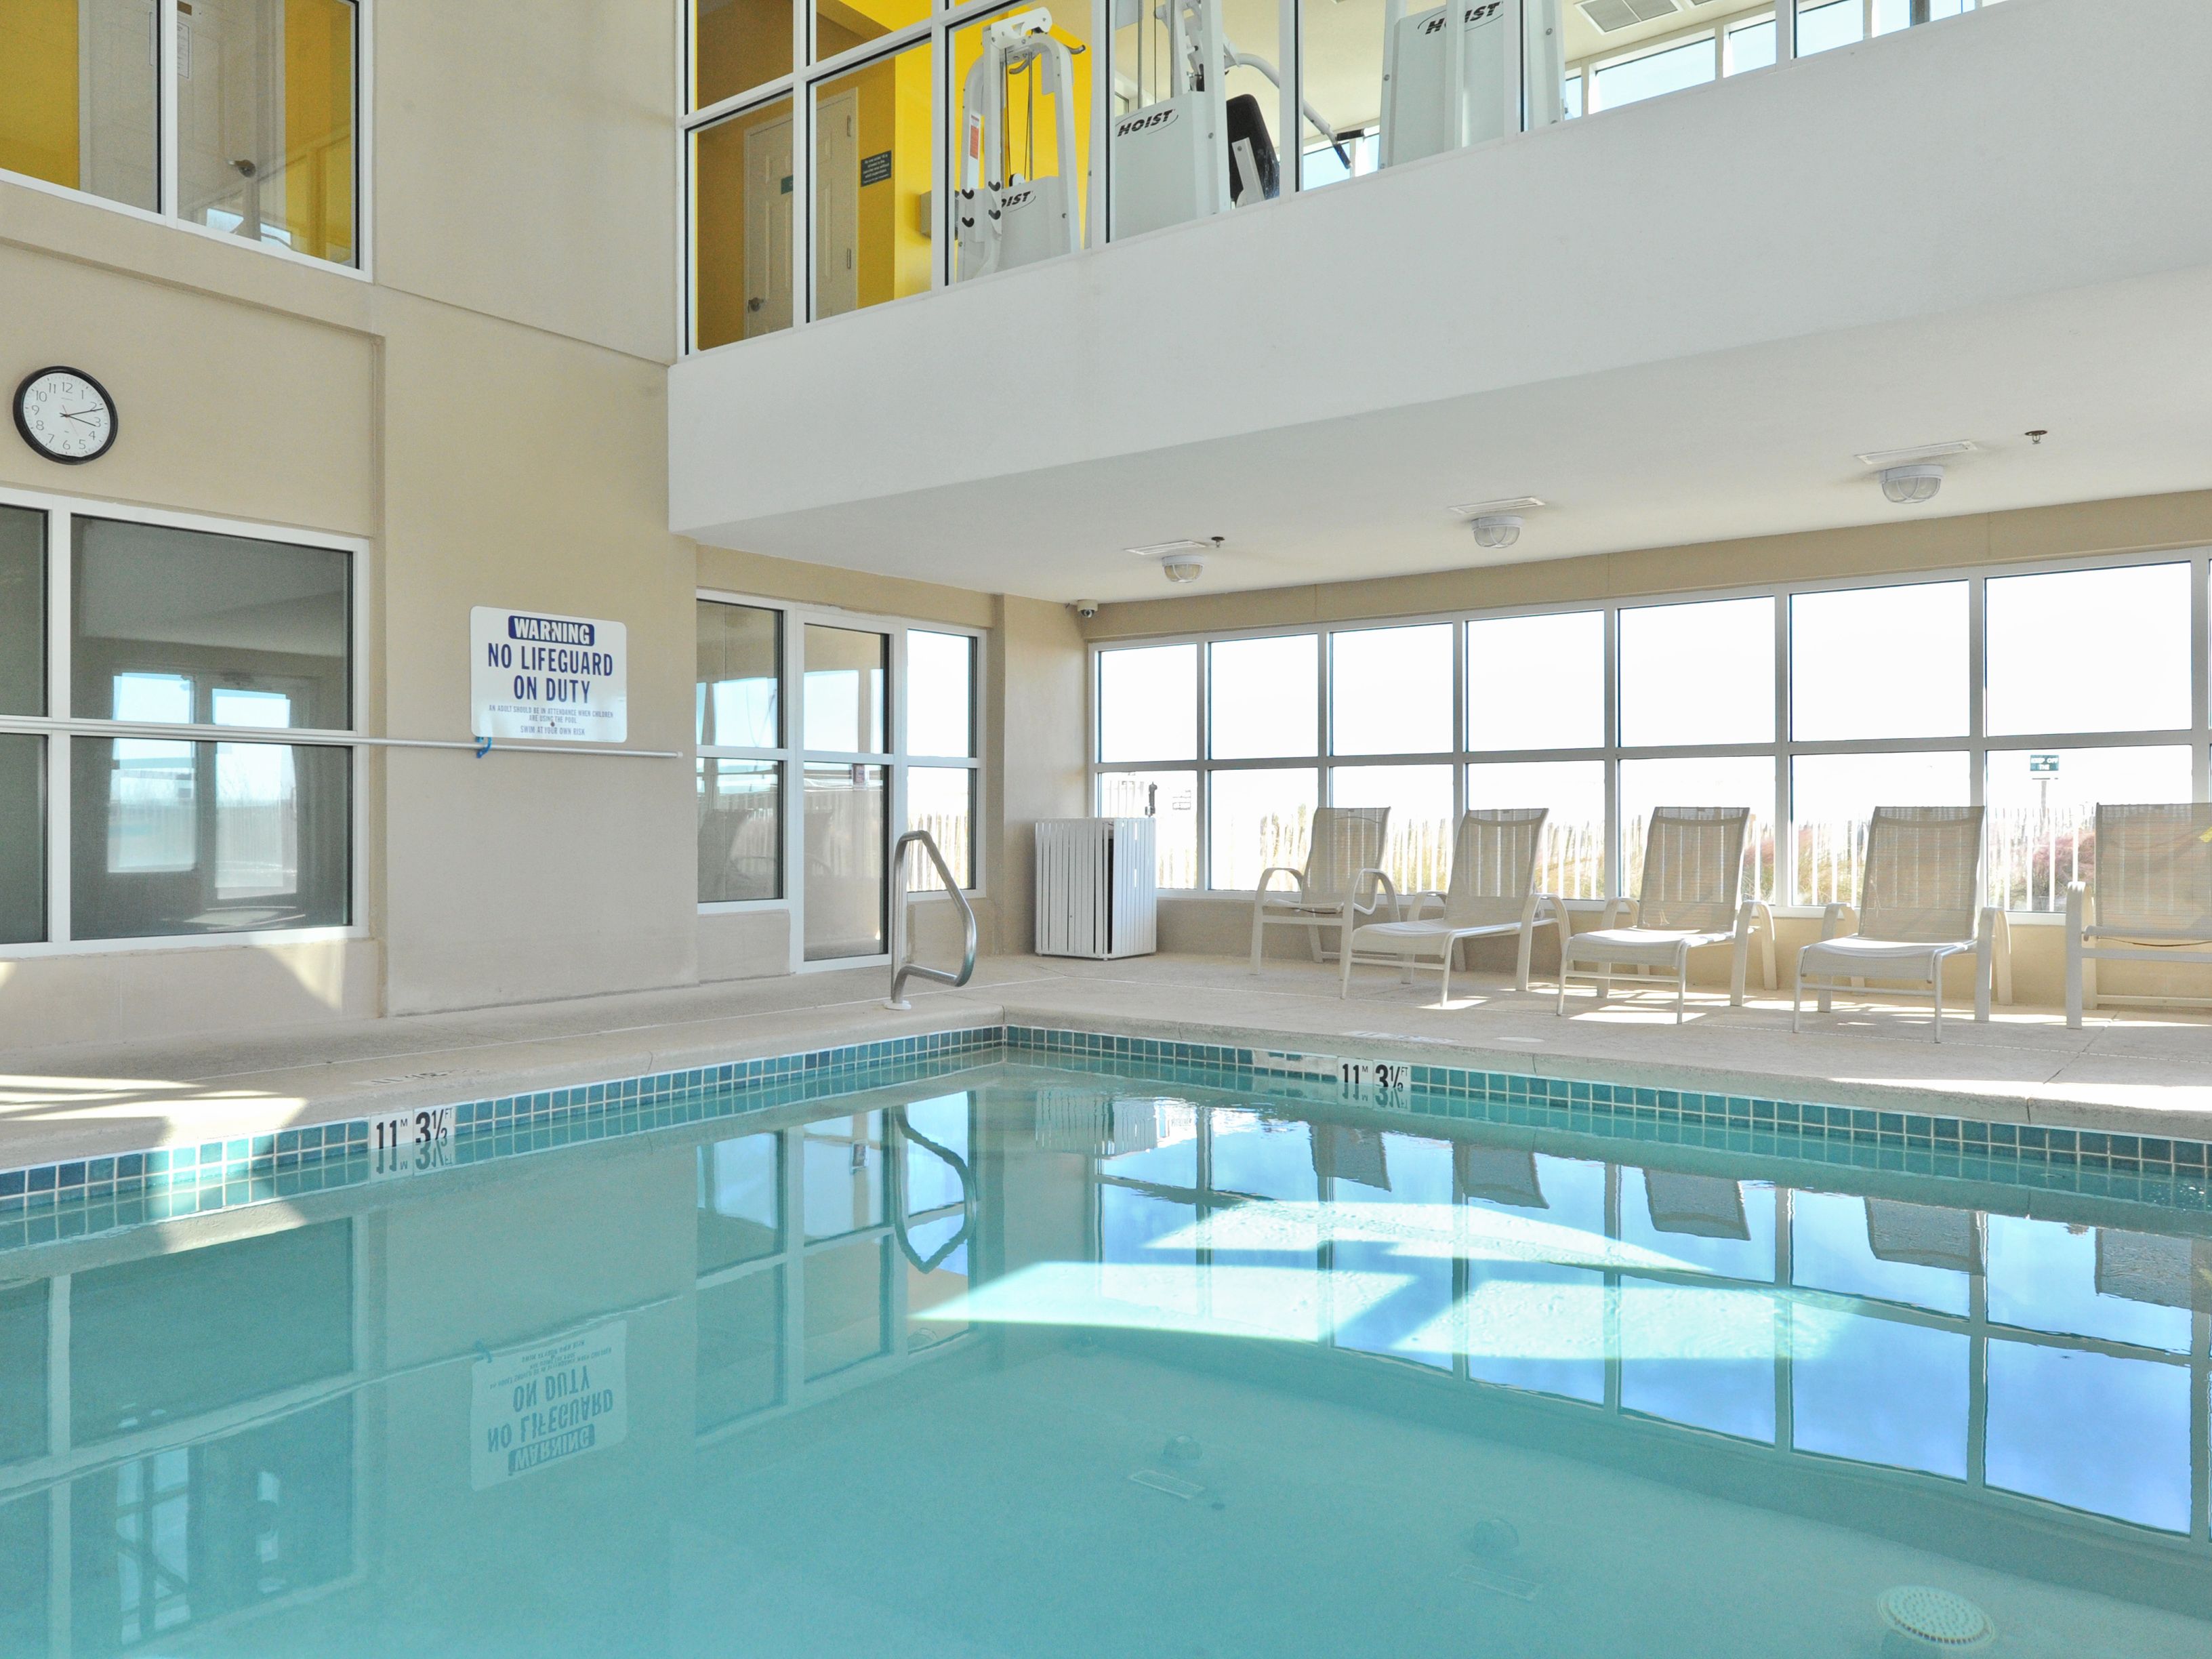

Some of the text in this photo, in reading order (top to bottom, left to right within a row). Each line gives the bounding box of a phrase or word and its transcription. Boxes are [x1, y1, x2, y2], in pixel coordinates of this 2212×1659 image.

[1118, 109, 1173, 137] HOIST
[49, 383, 56, 394] 11
[62, 382, 73, 394] 12
[36, 390, 47, 402] 10
[32, 405, 39, 415] 9
[36, 420, 44, 430] 8
[47, 434, 55, 444] 7
[89, 430, 96, 441] 4
[62, 440, 70, 450] 6
[79, 439, 86, 449] 5
[514, 617, 590, 644] WARNING
[488, 642, 613, 676] NO LIFEGUARD
[514, 675, 590, 703] ON DUTY
[513, 705, 533, 714] SHOULD
[548, 708, 577, 716] ATTENDANCE
[578, 709, 591, 717] WHEN
[592, 710, 613, 718] CHILDREN
[520, 725, 586, 736] SWIM AT YOUR OWN RISK
[445, 1108, 452, 1119] FT
